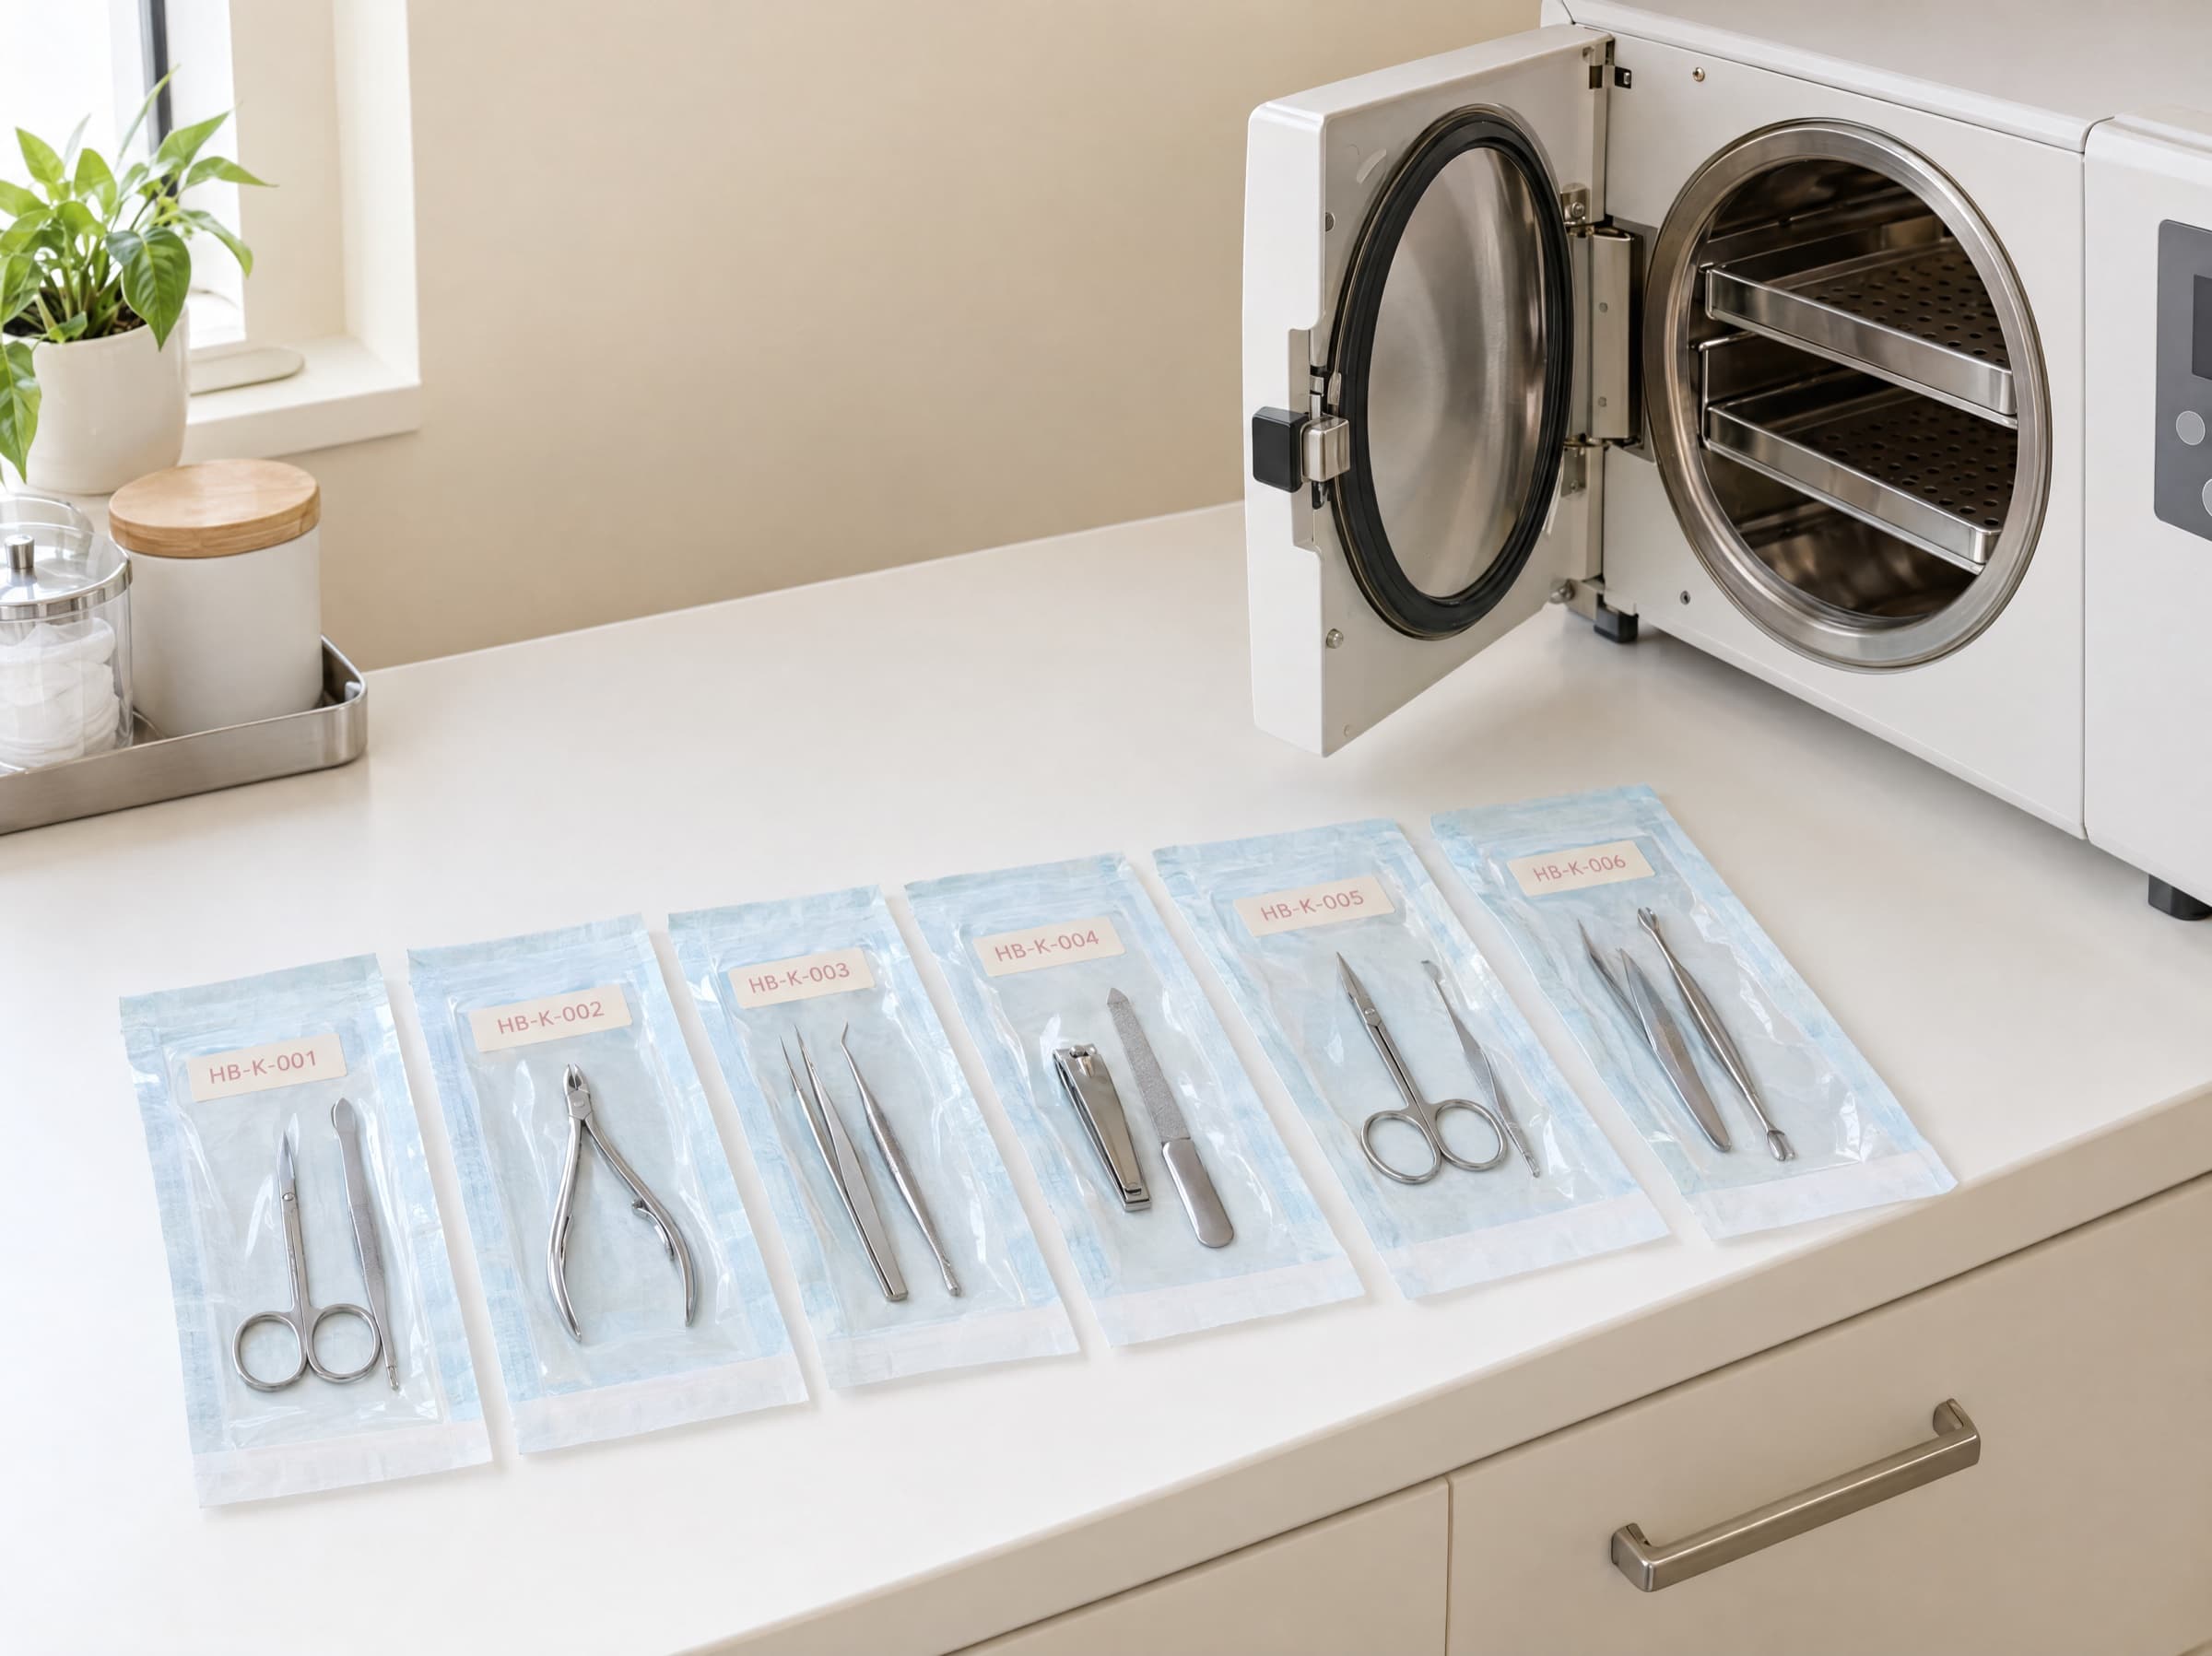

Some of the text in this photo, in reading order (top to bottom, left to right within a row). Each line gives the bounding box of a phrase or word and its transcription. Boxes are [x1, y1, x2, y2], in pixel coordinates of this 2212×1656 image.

[1533, 854, 1627, 883] HB-K-006
[1260, 889, 1364, 922] HB-K-005
[994, 930, 1100, 962] HB-K-004
[747, 962, 851, 994] HB-K-003
[497, 1001, 606, 1035] HB-K-002
[208, 1050, 317, 1085] HB-K-001
